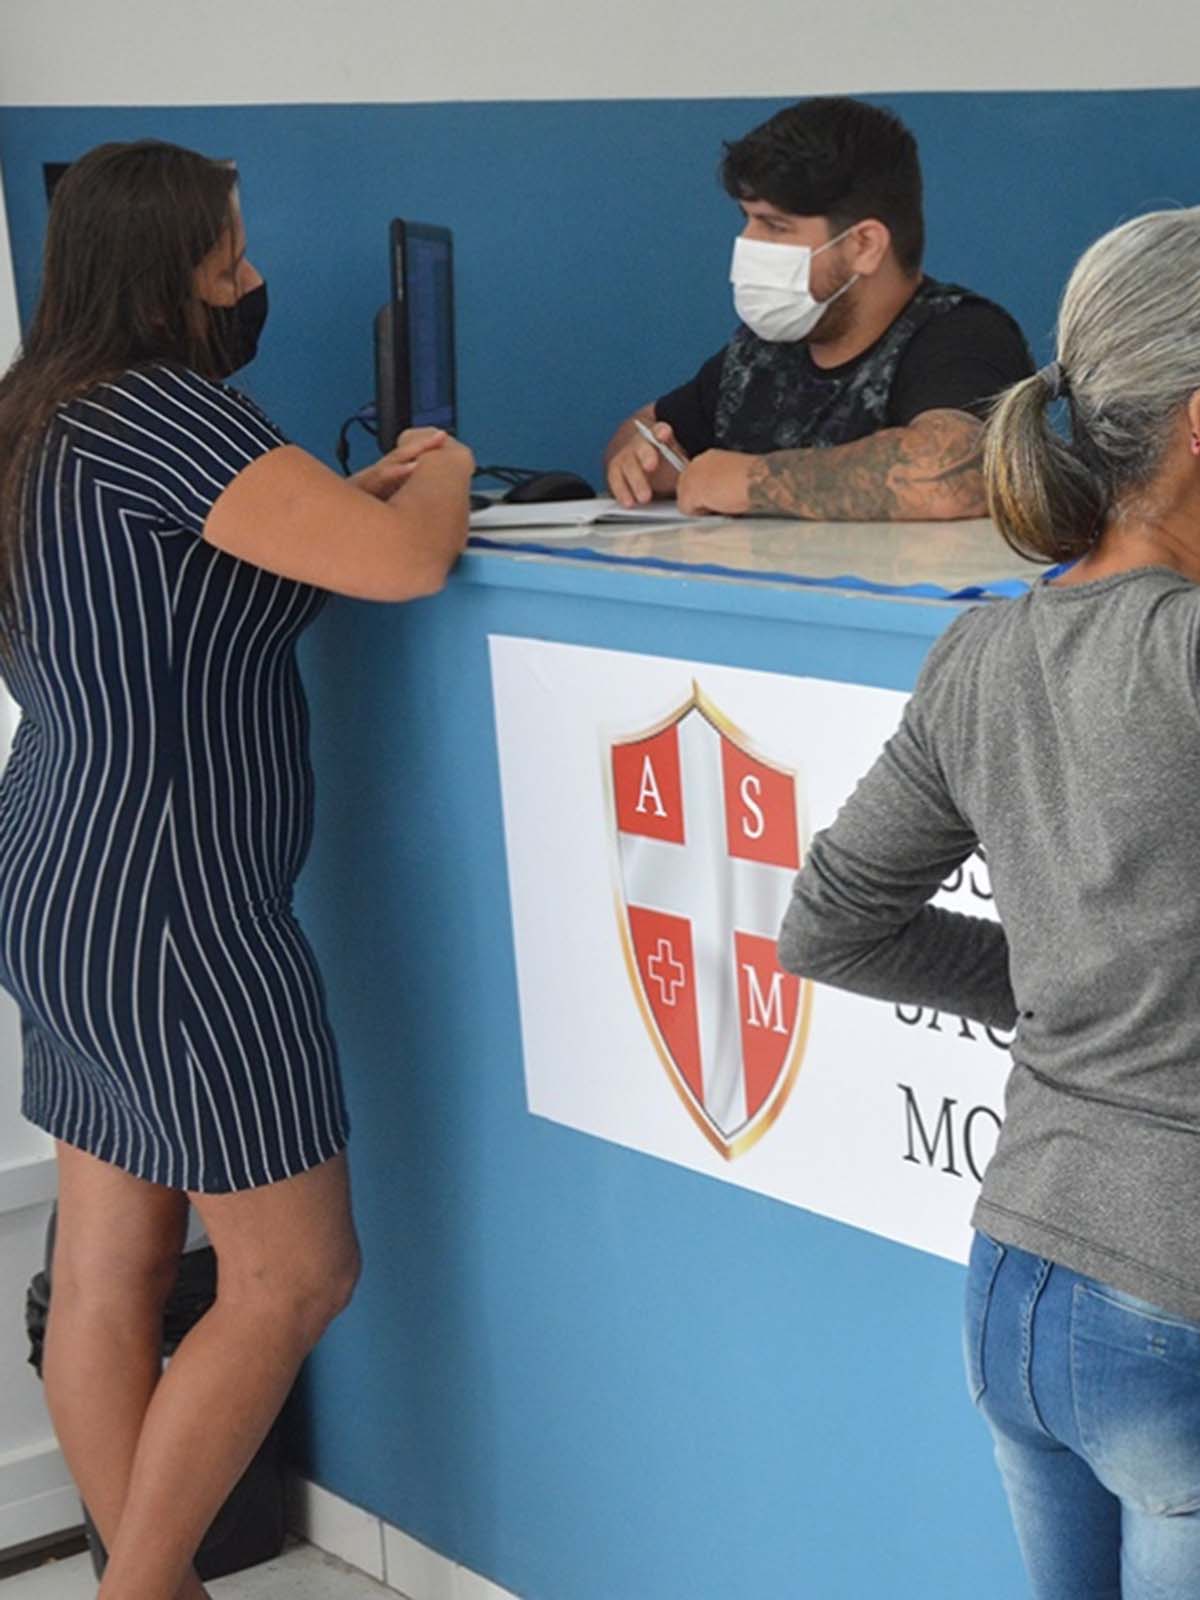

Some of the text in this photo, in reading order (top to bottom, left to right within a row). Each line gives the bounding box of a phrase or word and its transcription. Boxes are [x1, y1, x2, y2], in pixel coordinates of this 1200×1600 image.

[635, 755, 765, 839] A S
[742, 963, 789, 1035] M
